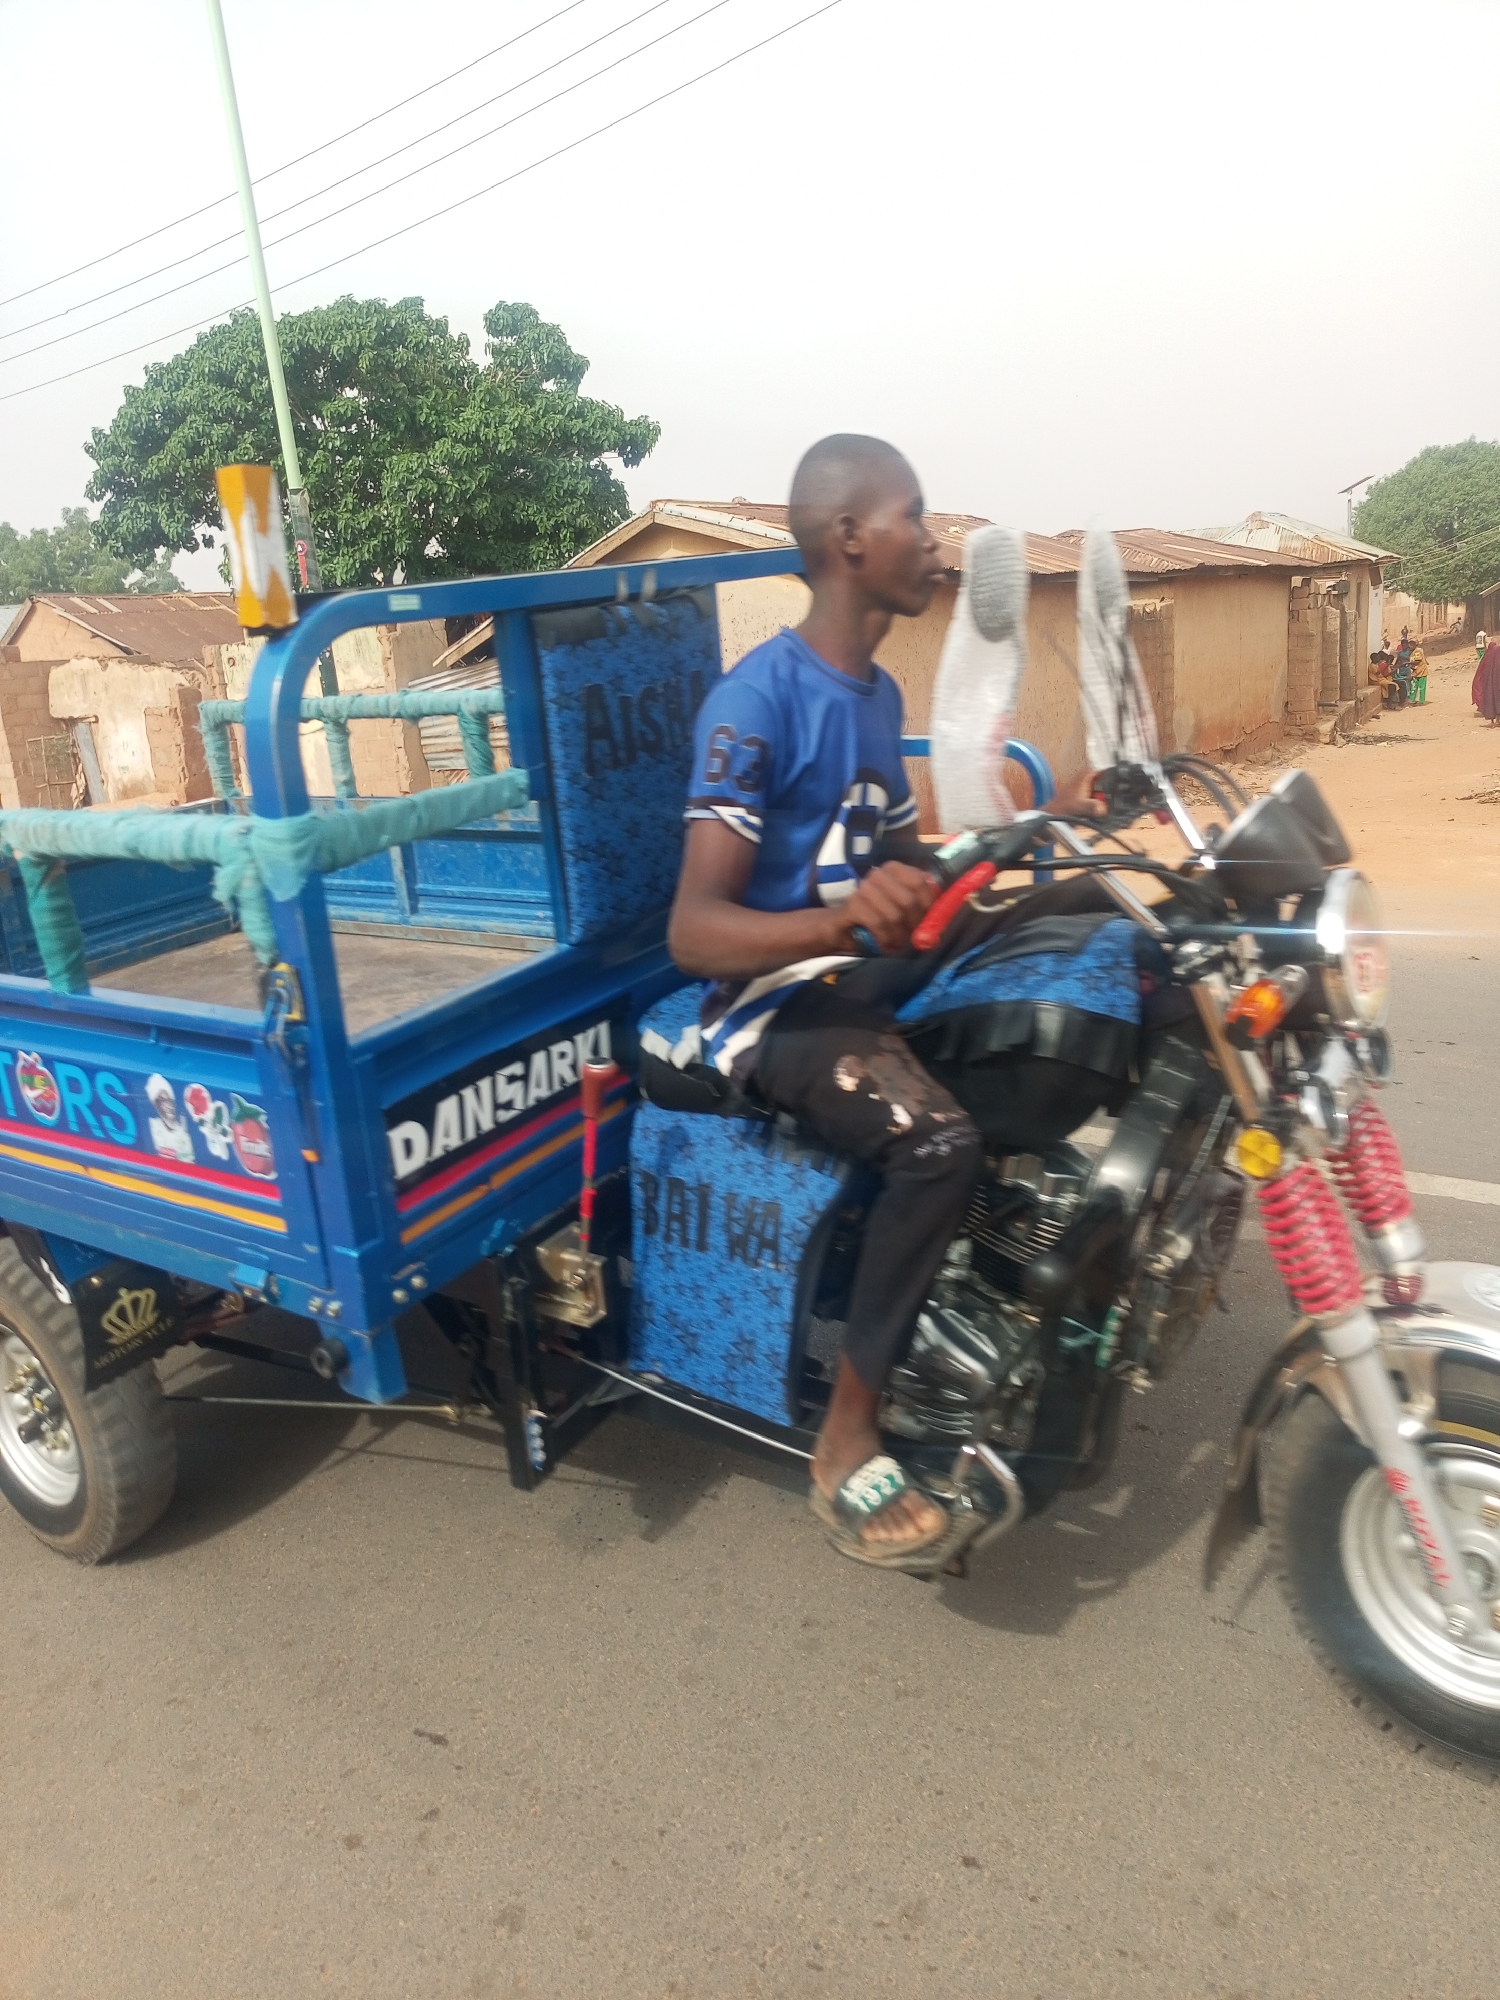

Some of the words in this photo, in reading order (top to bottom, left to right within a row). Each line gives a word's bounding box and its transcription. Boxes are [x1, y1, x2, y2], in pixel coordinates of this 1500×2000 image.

[704, 724, 773, 795] 63
[0, 1050, 137, 1146] TRS
[387, 1020, 612, 1180] DANSARKI
